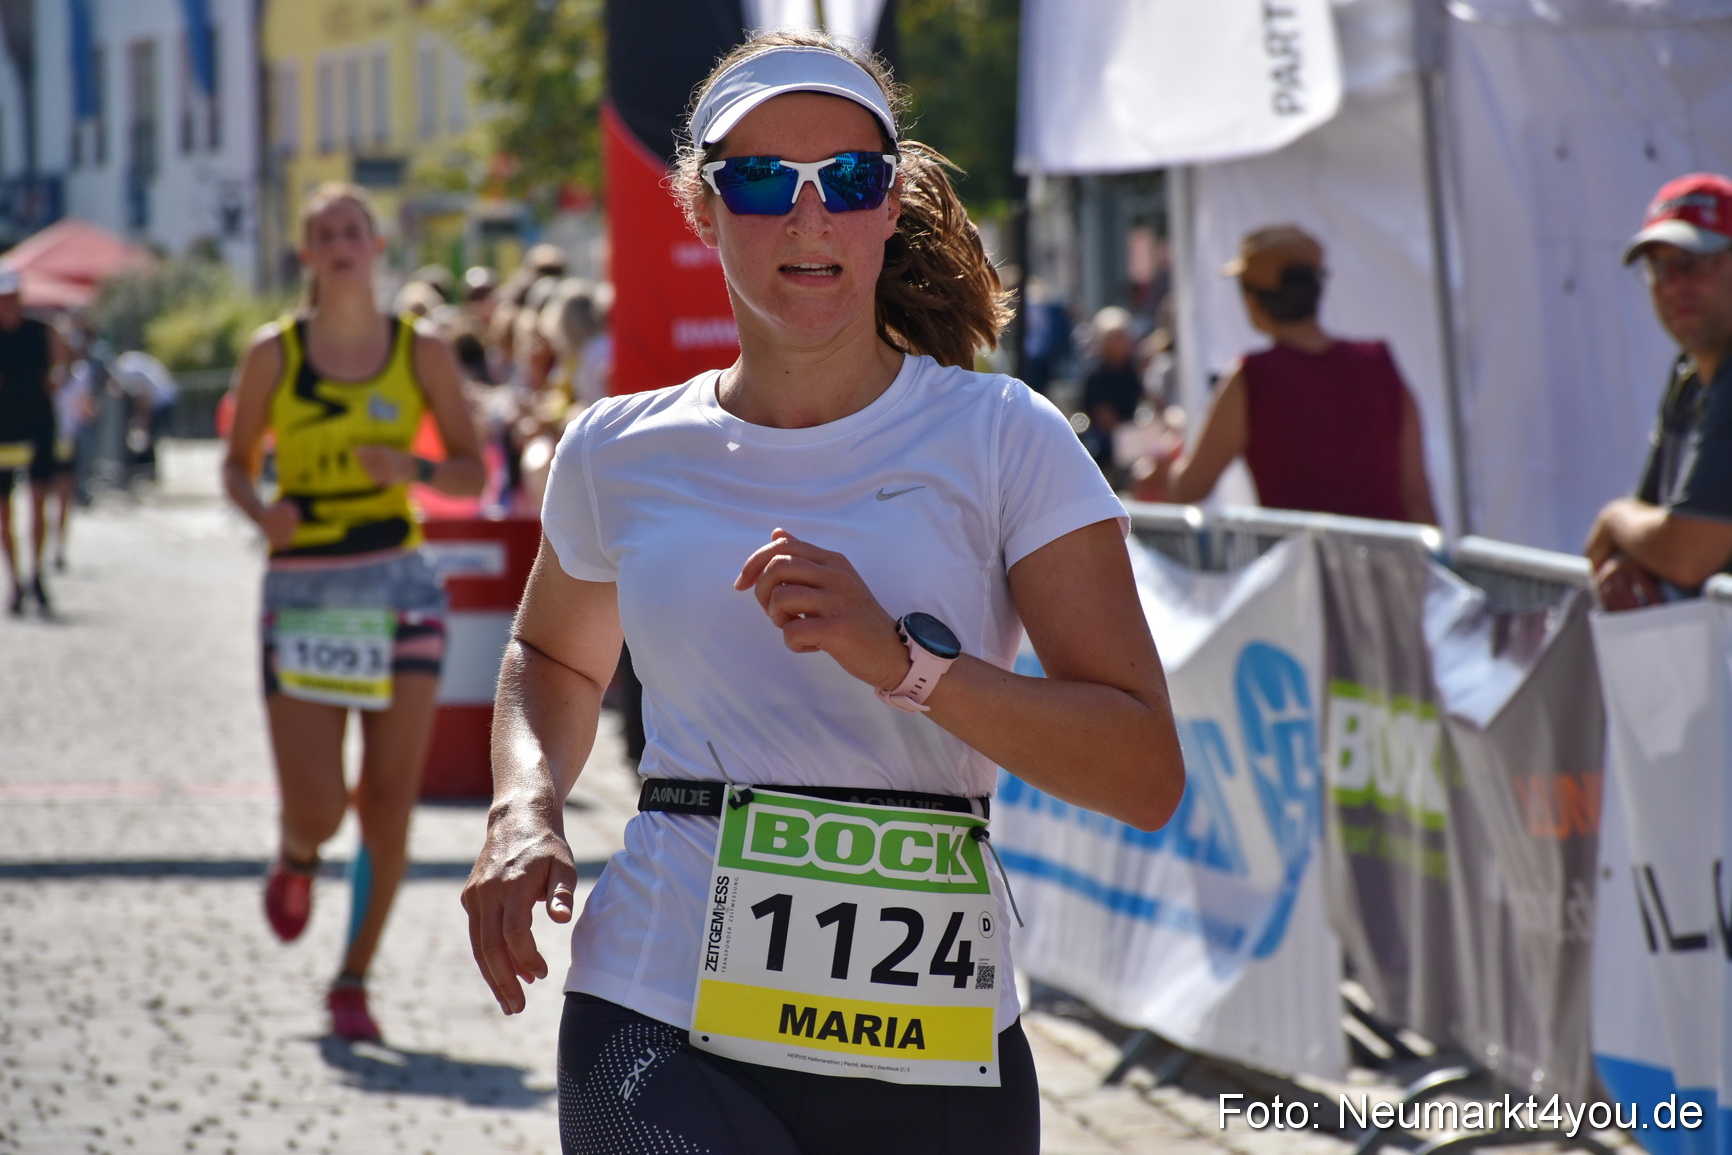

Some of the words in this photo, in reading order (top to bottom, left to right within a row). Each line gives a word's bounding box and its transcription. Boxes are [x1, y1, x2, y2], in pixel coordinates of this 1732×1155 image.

[744, 804, 977, 882] BOCK
[721, 926, 732, 973] TRANSPONDER
[728, 877, 739, 922] ZEITMESSUNG
[750, 893, 975, 989] 1124
[982, 917, 991, 932] D
[778, 1003, 926, 1050] MARIA
[807, 1056, 841, 1066] Halbmarathon
[877, 1064, 900, 1072] Startblock
